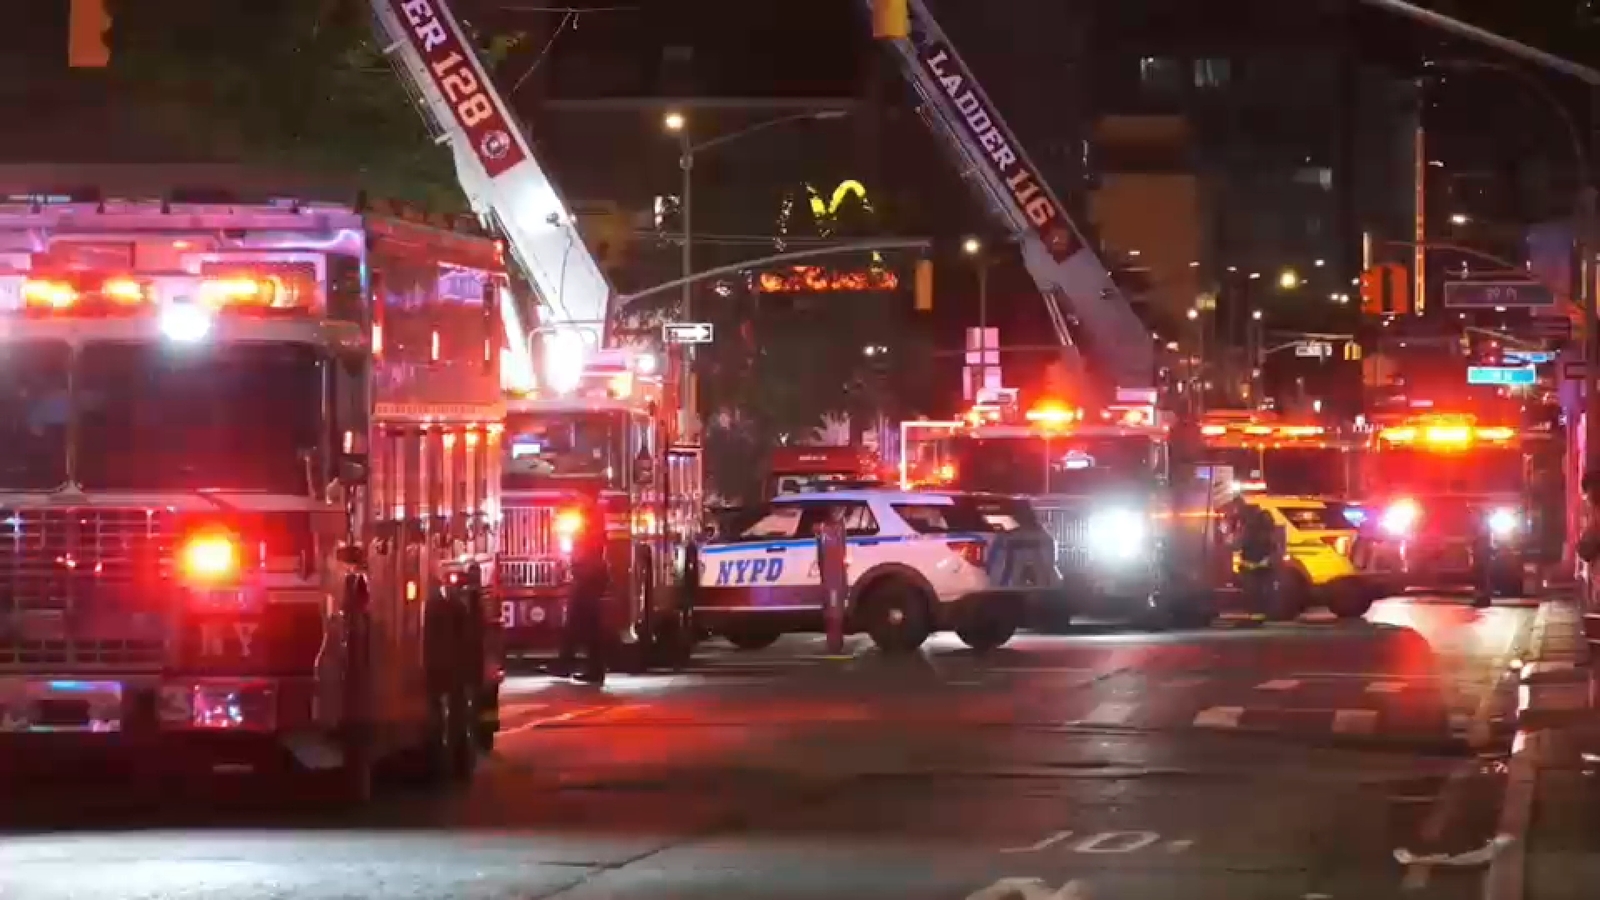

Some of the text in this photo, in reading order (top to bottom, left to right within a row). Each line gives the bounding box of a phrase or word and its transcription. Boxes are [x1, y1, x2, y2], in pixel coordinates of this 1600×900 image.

[432, 52, 493, 127] 128
[926, 50, 1055, 226] LADDER 116
[717, 558, 784, 586] NYPD
